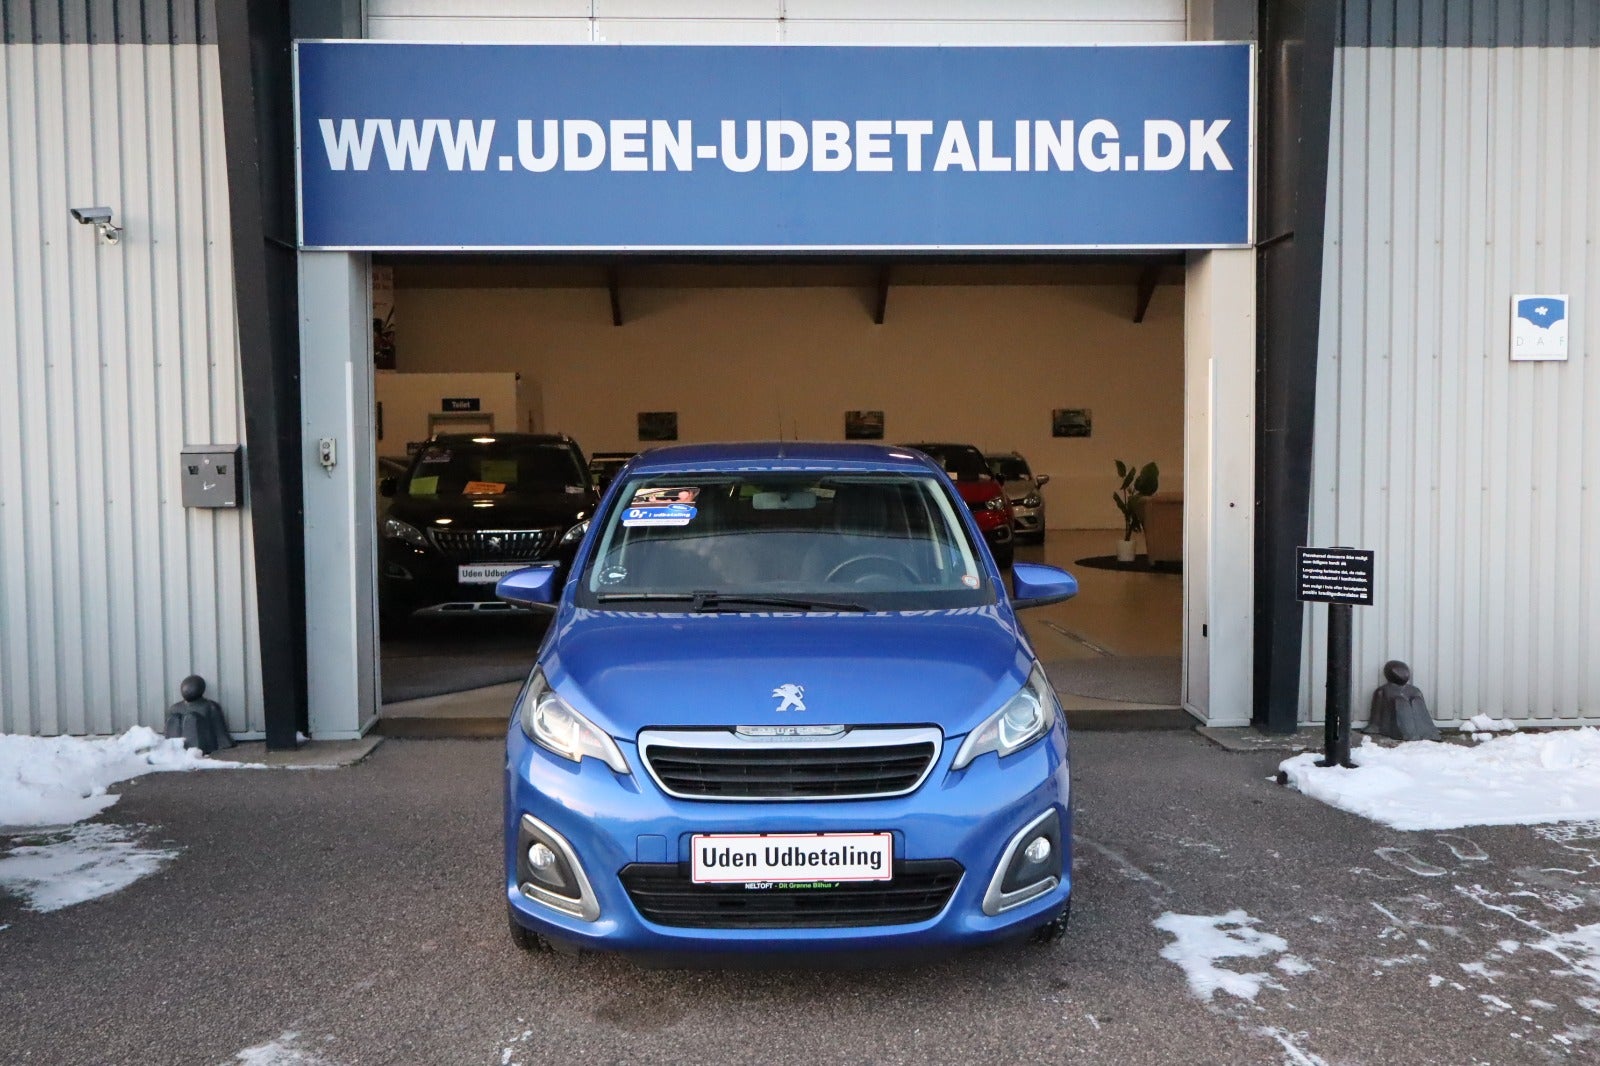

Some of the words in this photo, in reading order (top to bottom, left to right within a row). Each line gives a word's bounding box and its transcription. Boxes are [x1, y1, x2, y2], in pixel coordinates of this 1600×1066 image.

[318, 118, 1234, 172] WWW.UDEN-UDBETALING.DK
[452, 401, 471, 409] Toilet
[462, 569, 483, 578] Uden
[702, 847, 757, 867] Uden
[765, 845, 882, 870] Udbetaling
